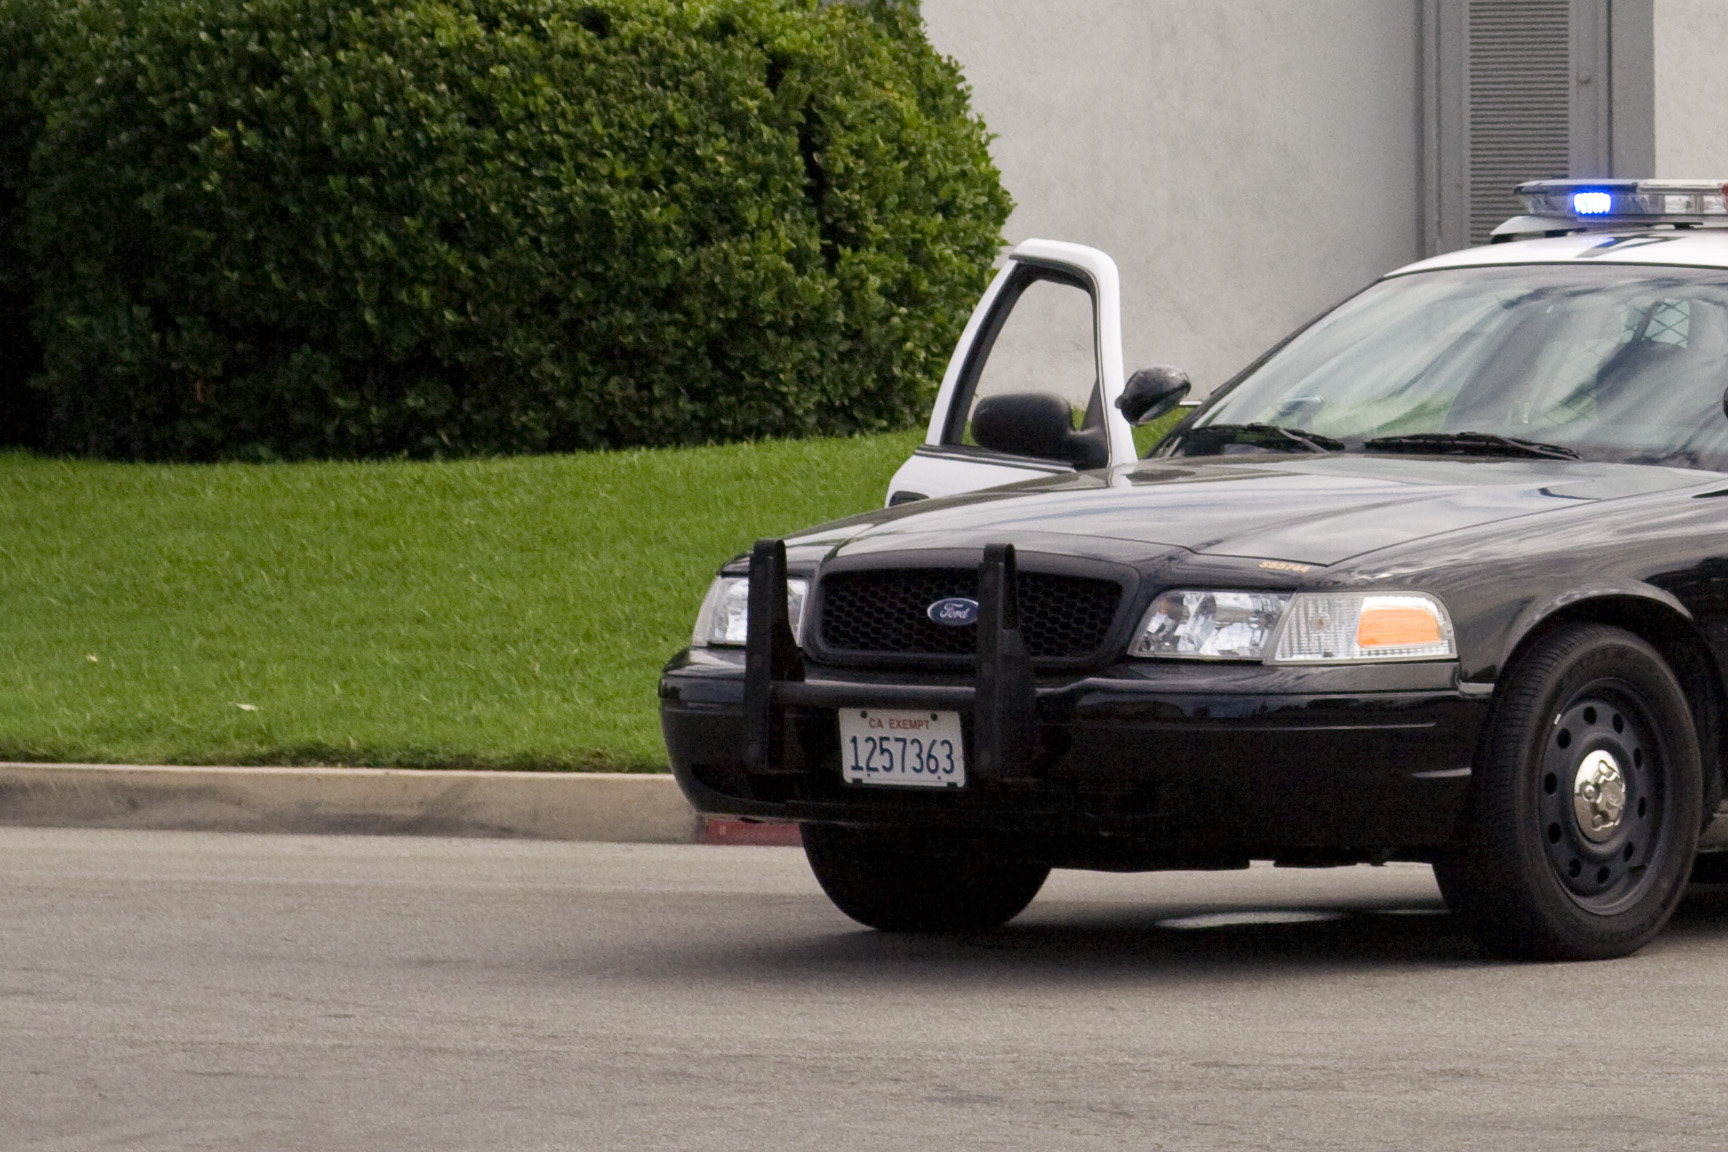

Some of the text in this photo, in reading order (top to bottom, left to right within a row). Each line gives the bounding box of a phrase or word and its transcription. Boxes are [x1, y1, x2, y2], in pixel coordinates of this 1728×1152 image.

[940, 603, 970, 618] Ford
[868, 717, 931, 730] CA EXEMPT
[850, 735, 955, 775] 1257363
